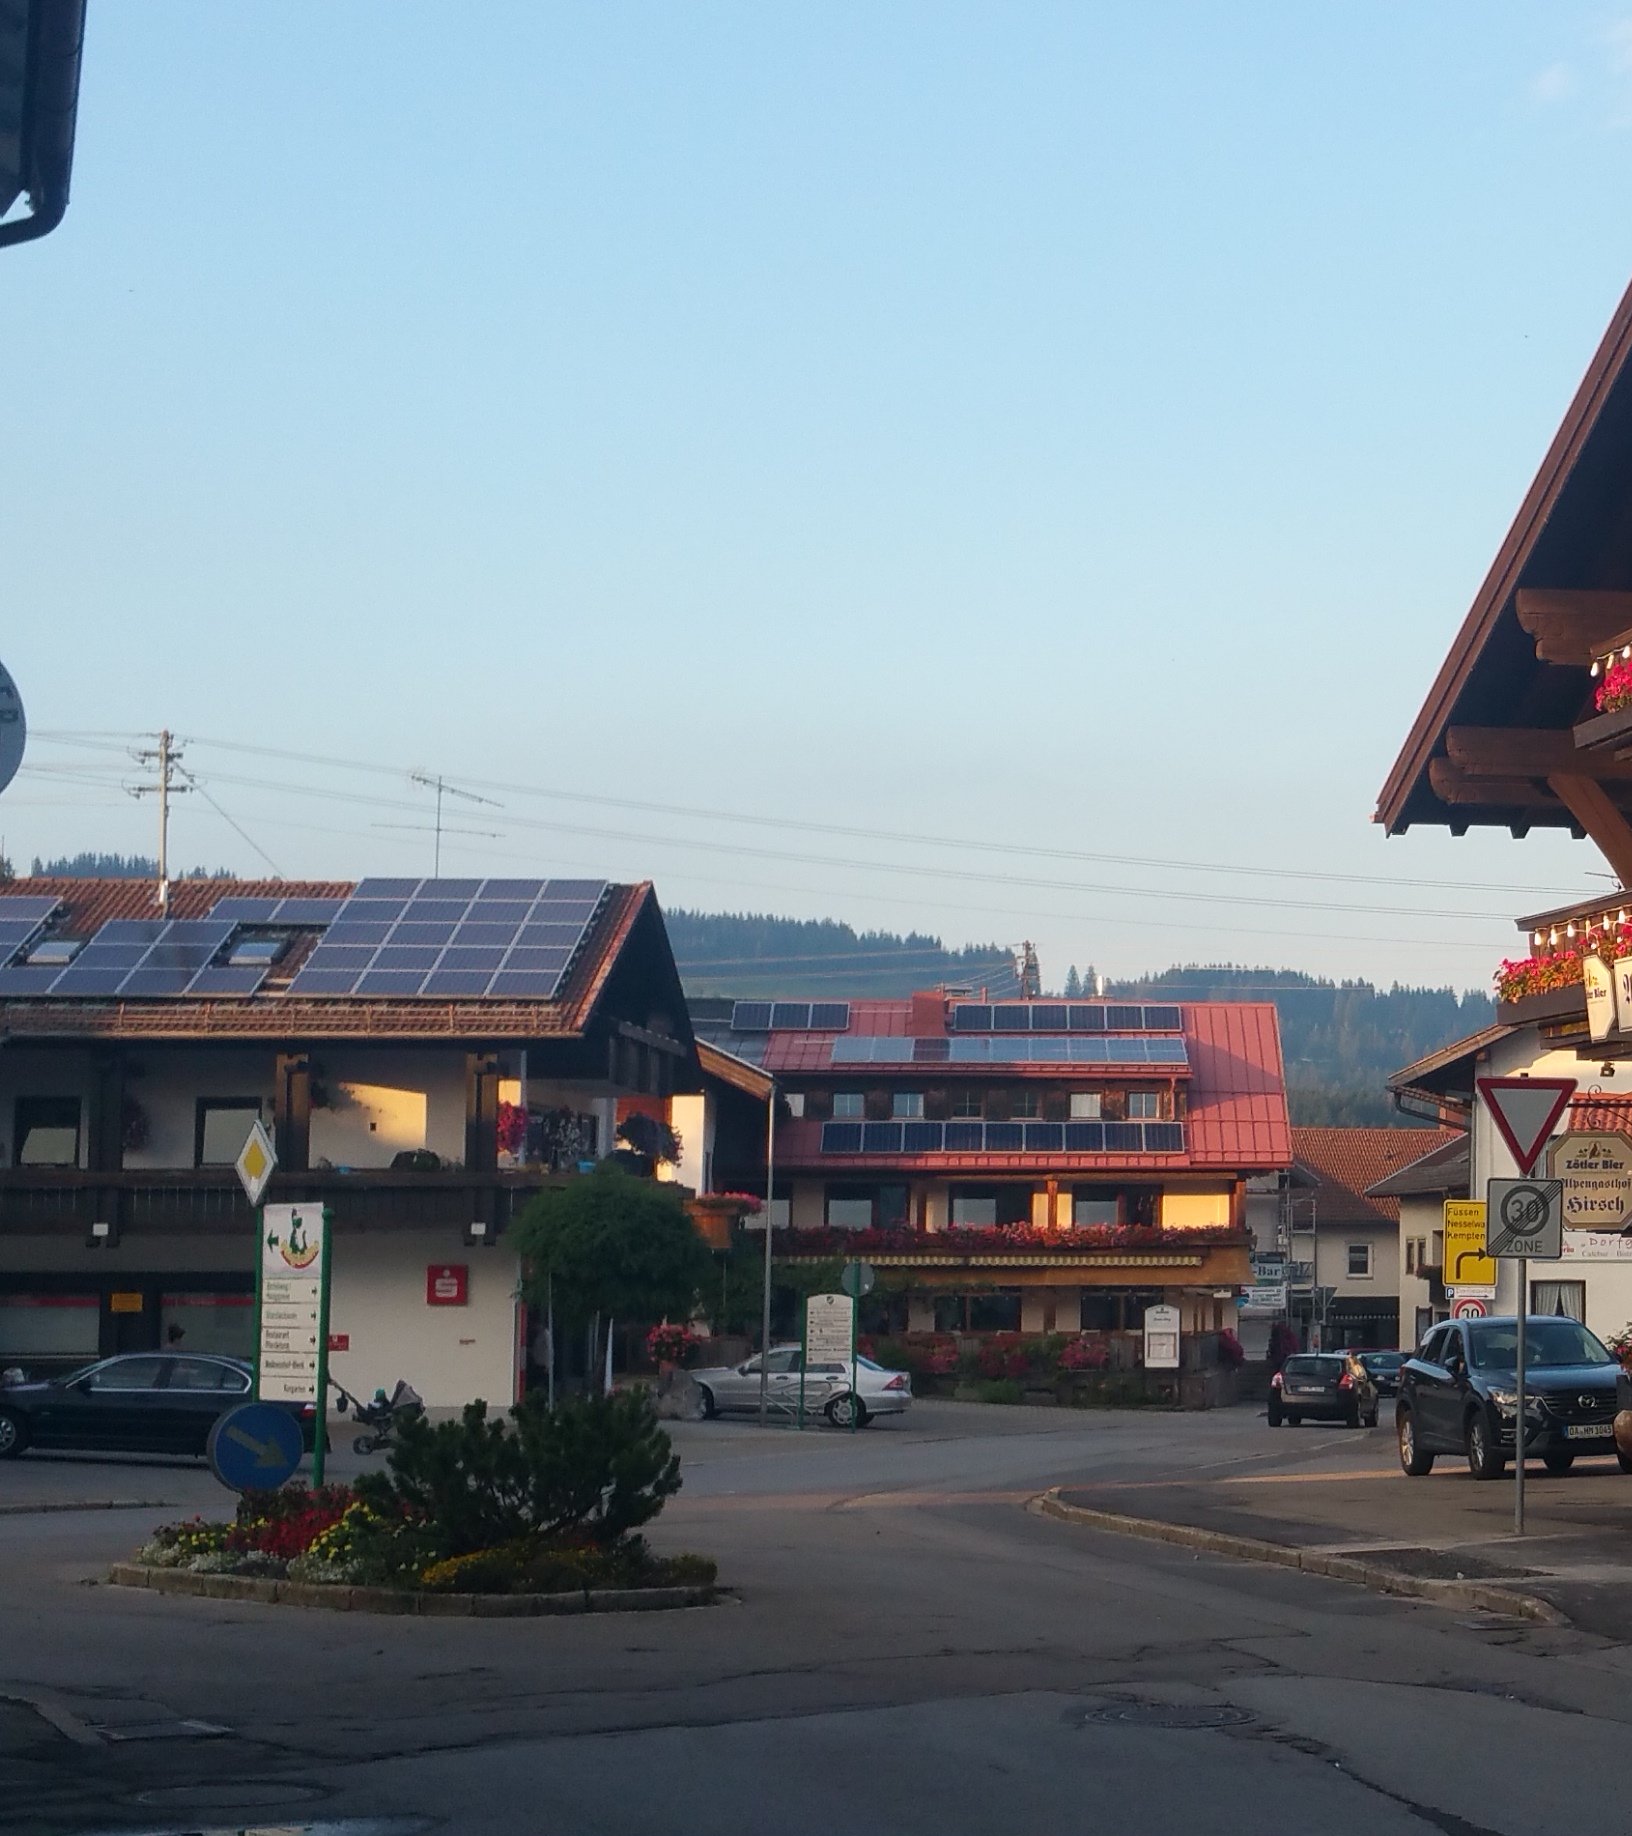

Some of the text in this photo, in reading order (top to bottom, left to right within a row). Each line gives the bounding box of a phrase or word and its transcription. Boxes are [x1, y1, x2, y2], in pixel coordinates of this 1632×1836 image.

[1566, 1159, 1624, 1170] Zötler Bier
[1511, 1199, 1539, 1223] 30
[1566, 1196, 1625, 1215] Hirsch
[1447, 1207, 1479, 1217] Füssen
[1447, 1219, 1486, 1229] Nesselwa
[1447, 1231, 1486, 1241] Kempten
[1506, 1240, 1543, 1253] ZONE
